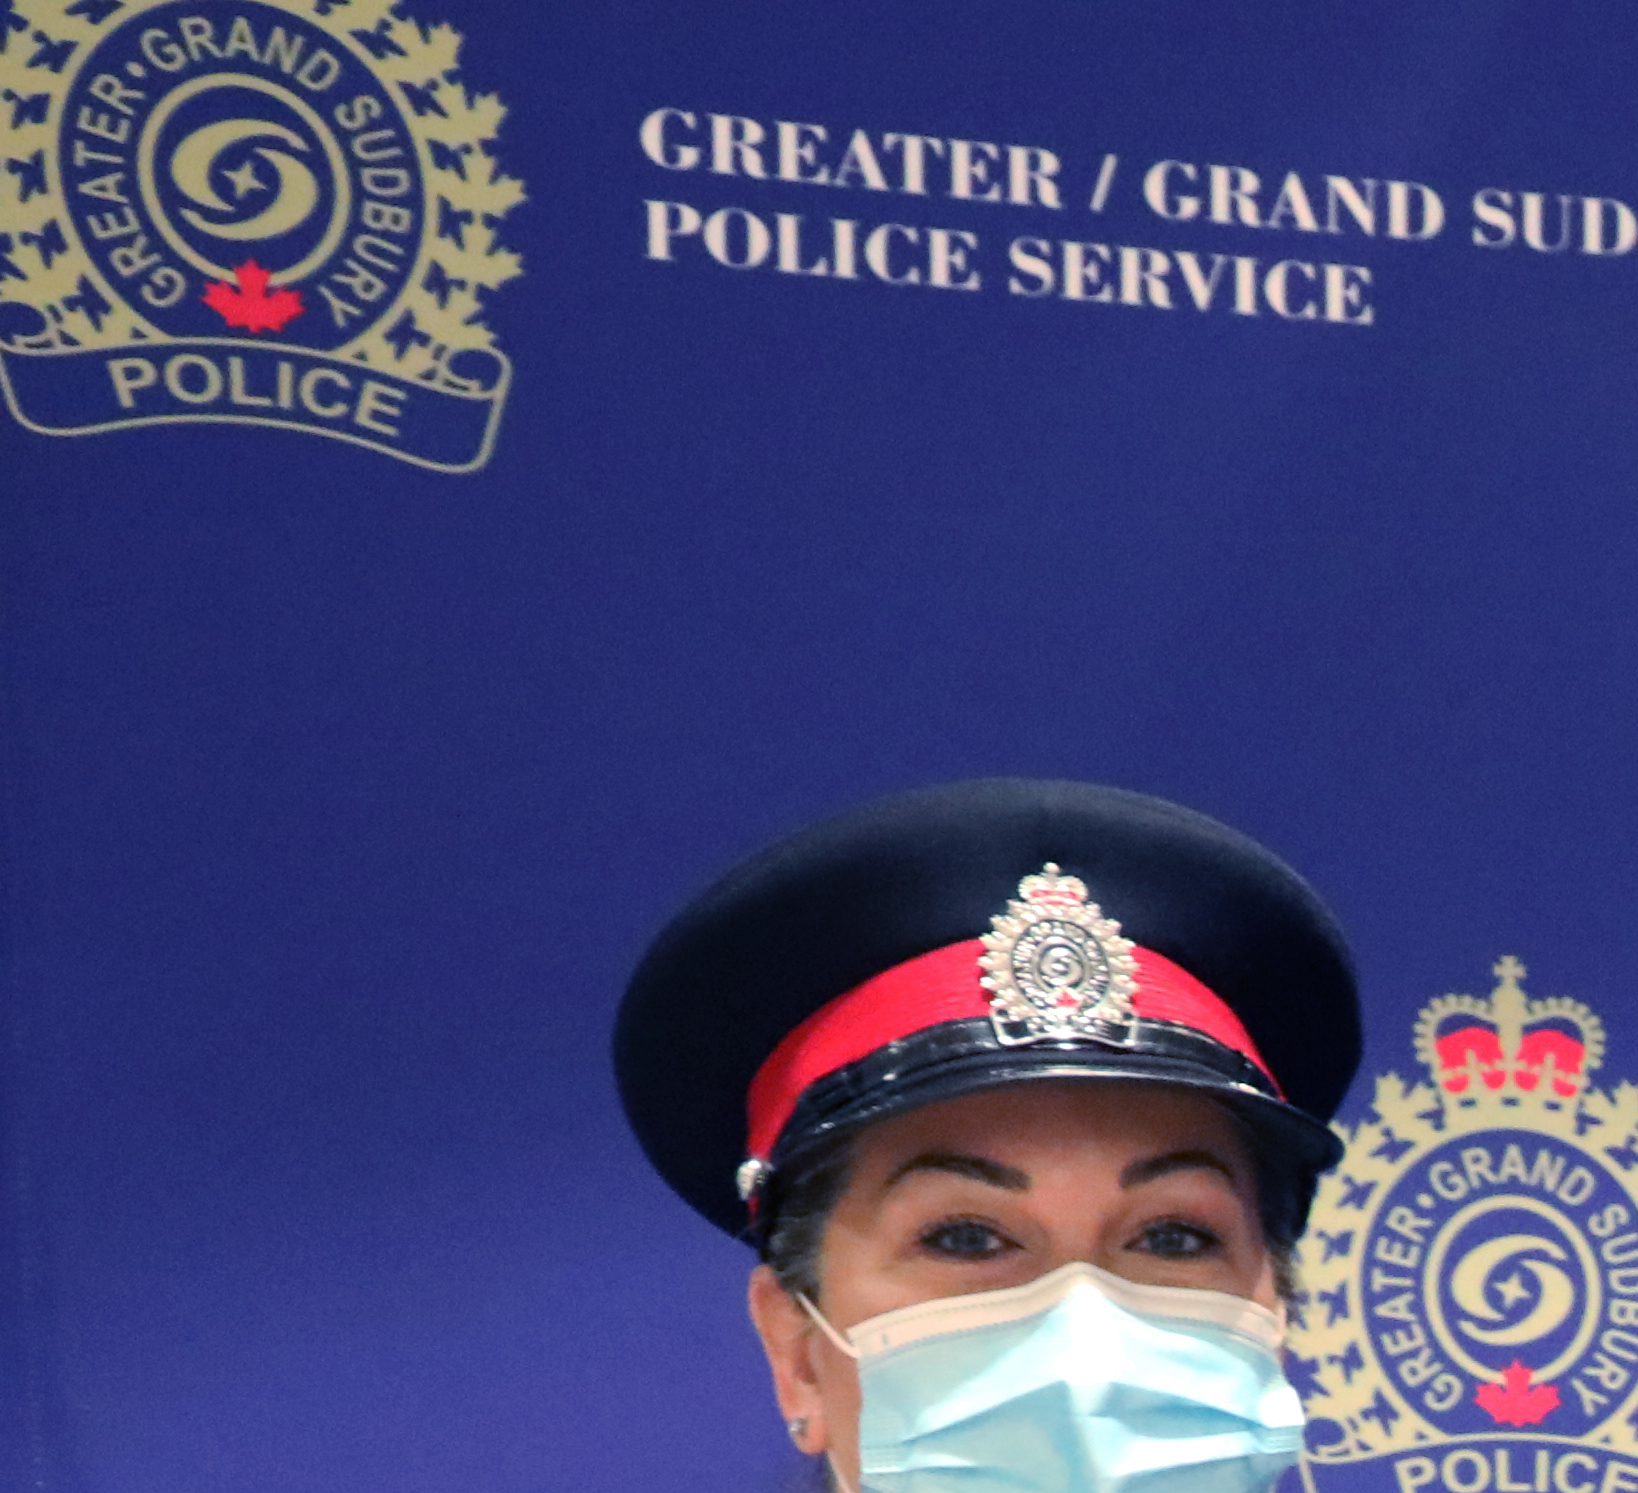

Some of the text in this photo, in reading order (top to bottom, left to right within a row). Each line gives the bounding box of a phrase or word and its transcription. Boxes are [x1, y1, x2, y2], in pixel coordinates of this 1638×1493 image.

[143, 14, 341, 94] GRAND
[330, 92, 411, 330] SUDBURY
[637, 107, 1064, 212] GREATER
[1141, 158, 1447, 242] GRAND
[643, 198, 1376, 327] POLICE SERVICE
[105, 355, 407, 437] POLICE
[1428, 1143, 1597, 1208] GRAND
